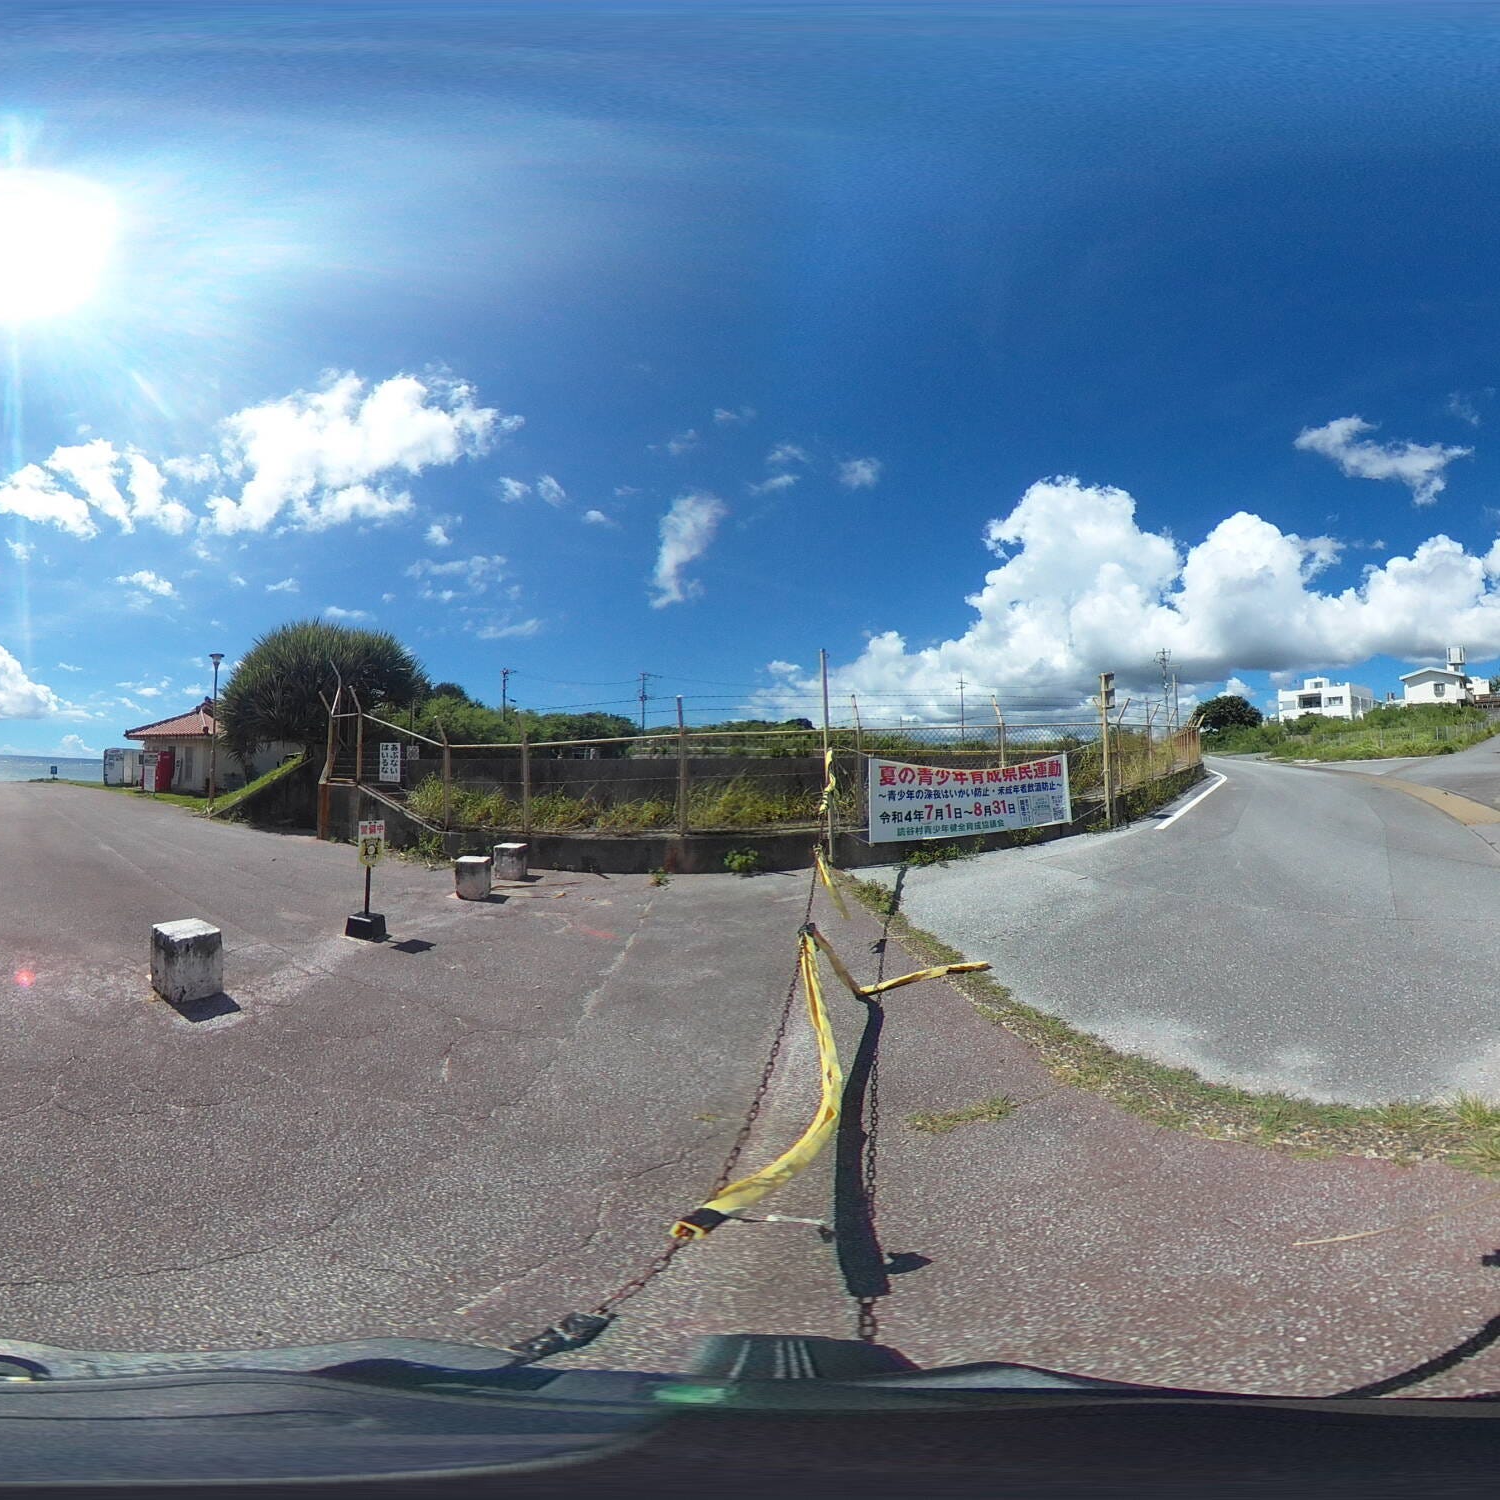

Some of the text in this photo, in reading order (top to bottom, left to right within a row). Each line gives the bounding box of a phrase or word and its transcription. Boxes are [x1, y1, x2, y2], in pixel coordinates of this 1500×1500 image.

[381, 744, 389, 774] はいるな
[390, 744, 399, 774] あぶない
[879, 760, 1062, 786] 夏の青少年育成県民運動
